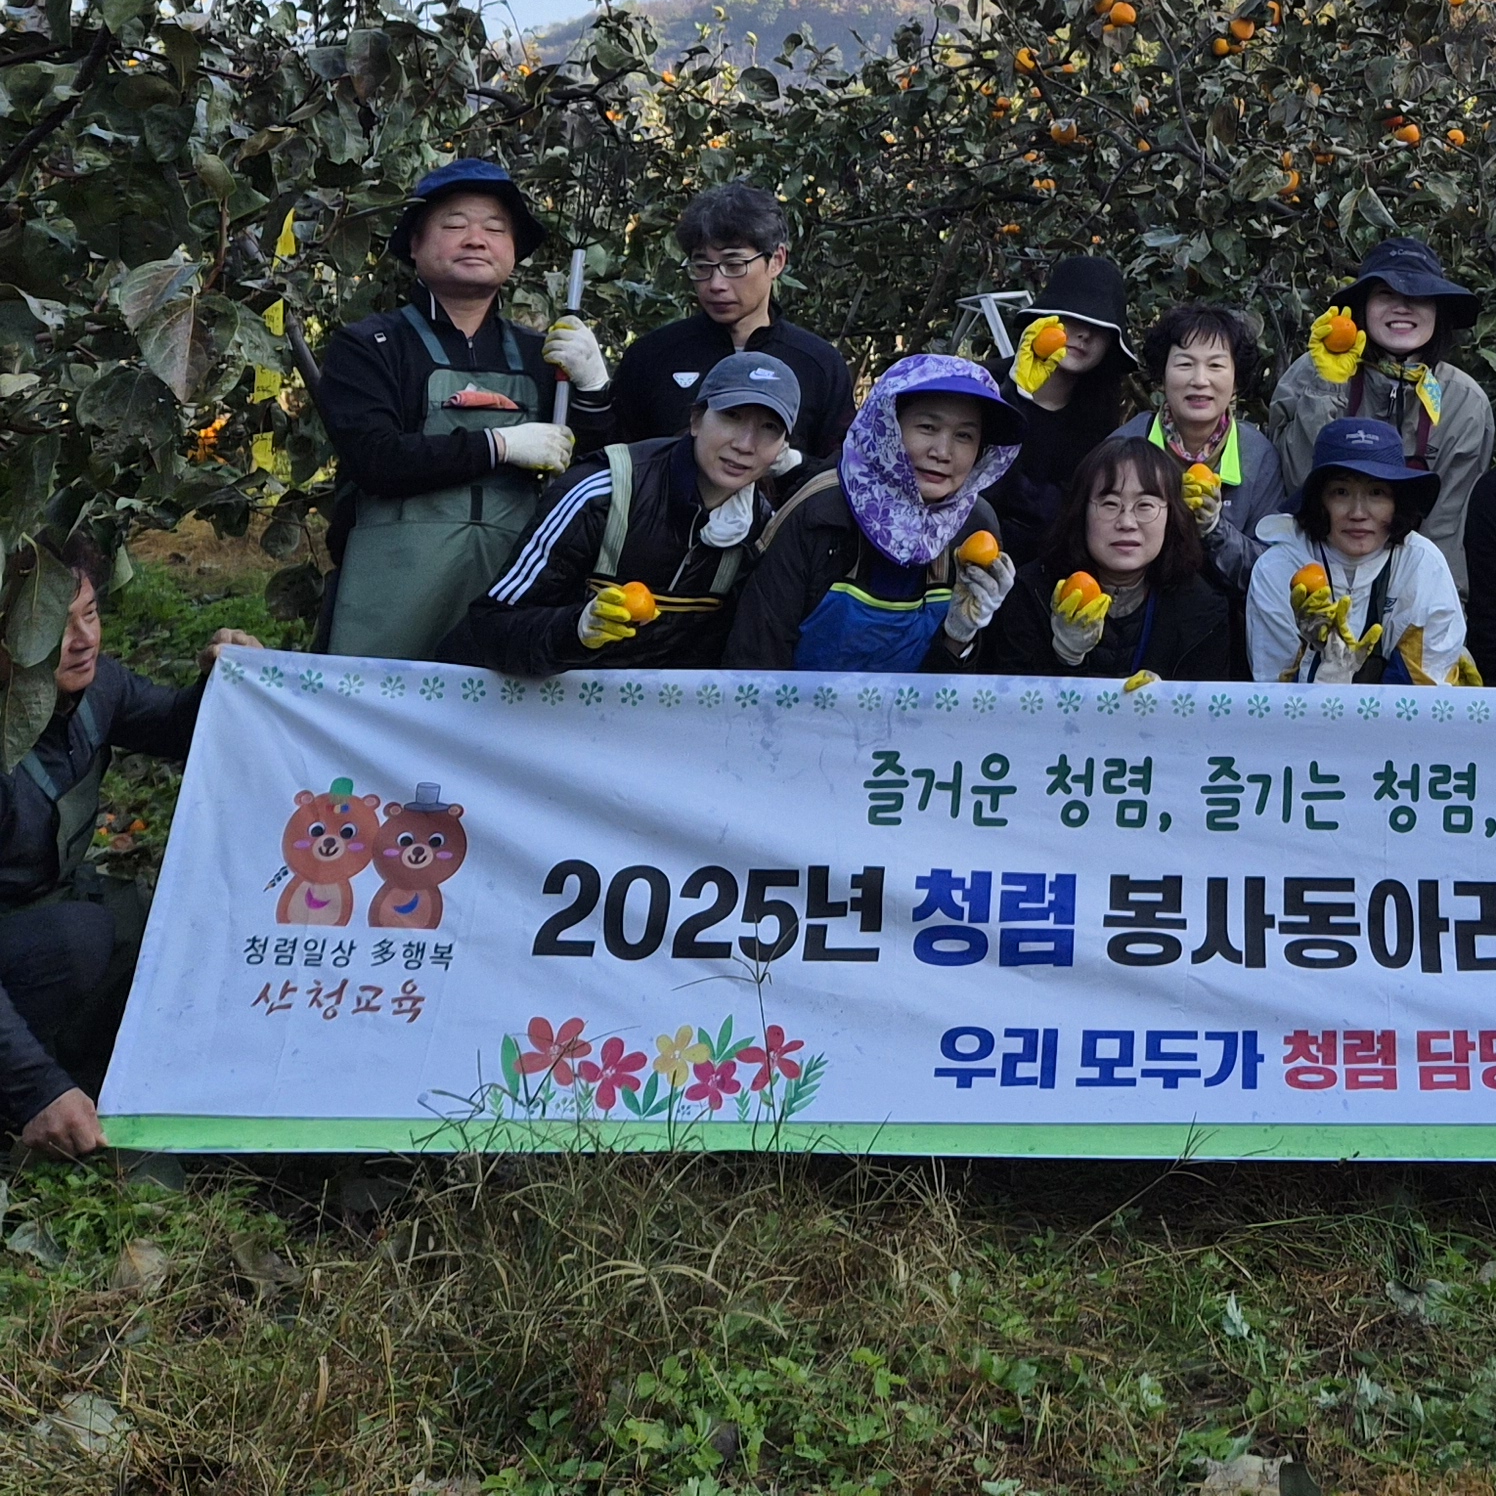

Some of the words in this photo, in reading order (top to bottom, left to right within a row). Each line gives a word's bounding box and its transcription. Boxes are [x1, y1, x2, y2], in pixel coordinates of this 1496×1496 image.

[863, 750, 1018, 828] 즐거운
[1045, 753, 1173, 832] 청렴,
[1202, 756, 1345, 831] 즐기는
[532, 859, 884, 962] 2025년
[911, 868, 1077, 968] 청렴
[243, 935, 357, 968] 청렴일상
[370, 937, 455, 971] 多행복
[250, 978, 426, 1023] 산청교육
[934, 1026, 1057, 1088] 우리
[1075, 1028, 1265, 1090] 모두가
[1282, 1029, 1398, 1091] 청렴
